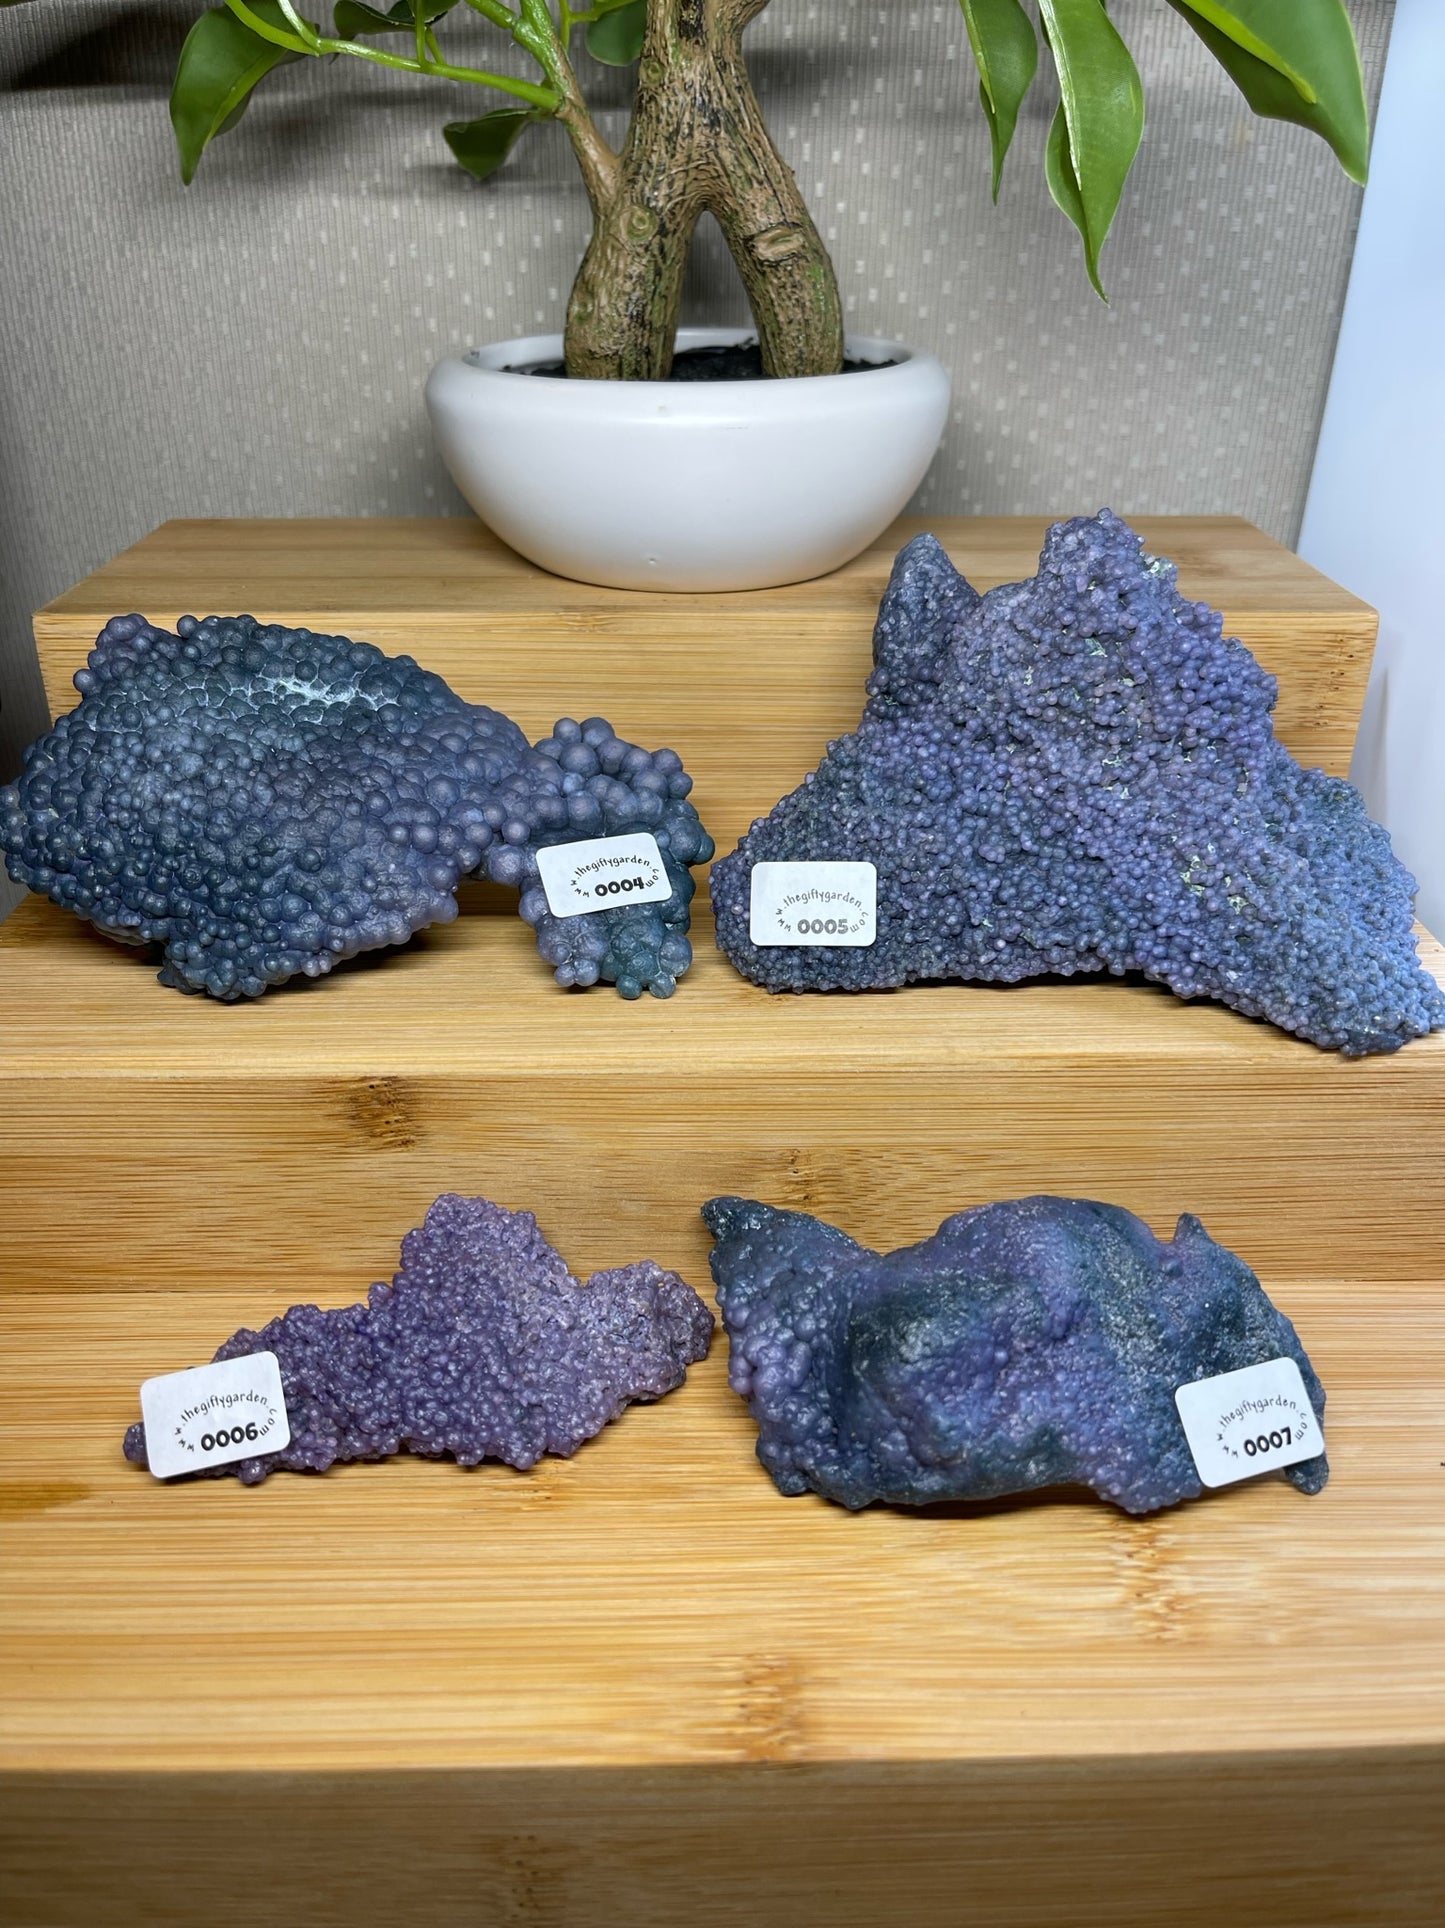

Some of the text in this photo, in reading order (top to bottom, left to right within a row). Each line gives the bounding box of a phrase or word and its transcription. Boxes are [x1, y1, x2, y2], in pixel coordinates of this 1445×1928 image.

[595, 876, 644, 896] 0004
[797, 918, 849, 934] 0005
[201, 1422, 259, 1451] 0006
[1244, 1426, 1292, 1457] 0007
